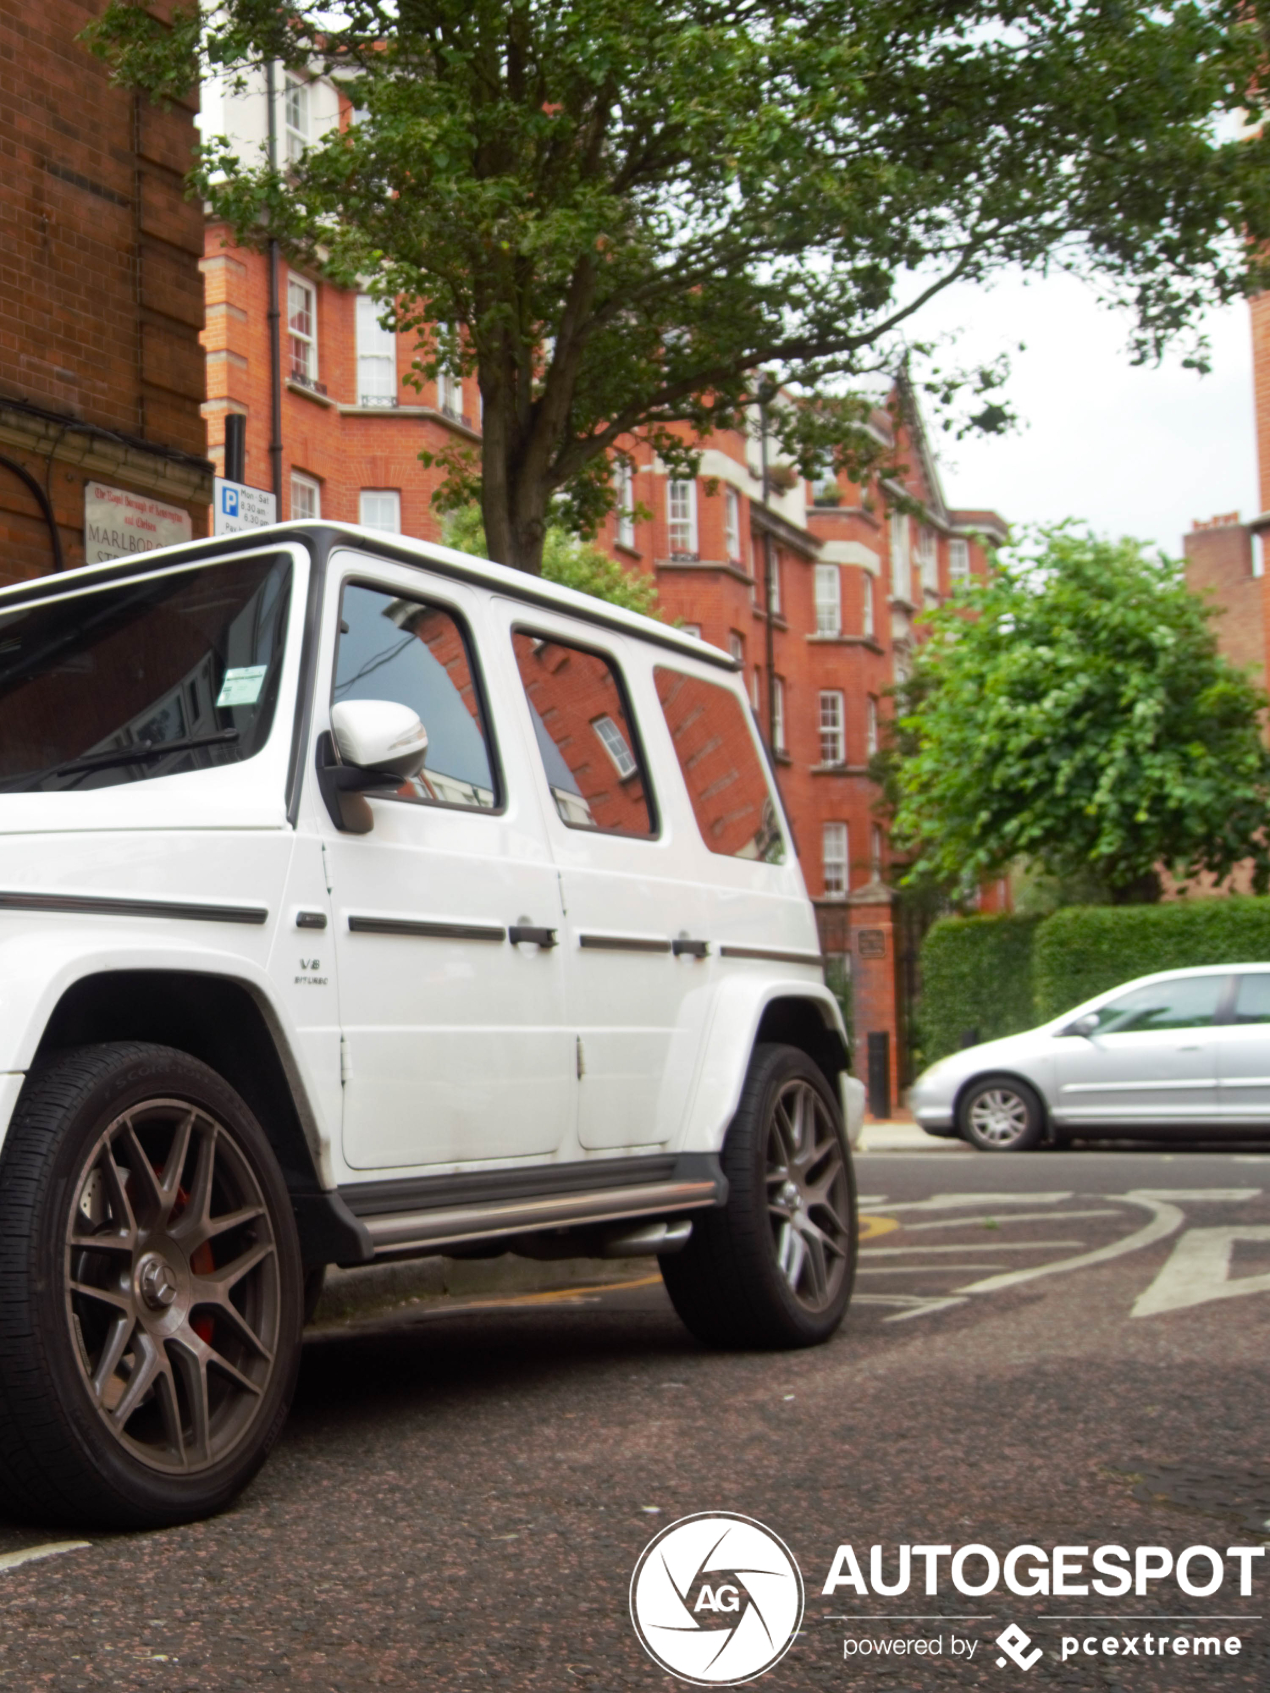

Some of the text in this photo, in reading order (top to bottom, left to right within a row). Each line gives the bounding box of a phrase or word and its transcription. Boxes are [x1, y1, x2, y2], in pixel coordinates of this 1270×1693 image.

[226, 489, 237, 513] P
[241, 489, 254, 500] Mon
[259, 494, 270, 505] Sat
[94, 487, 183, 523] The Royal Borough of Kensington
[241, 501, 256, 512] 8.30
[257, 507, 266, 516] am
[124, 515, 157, 532] and Chelsea
[244, 513, 259, 525] 6.30
[300, 958, 320, 970] V8
[294, 976, 329, 985] BITURBO
